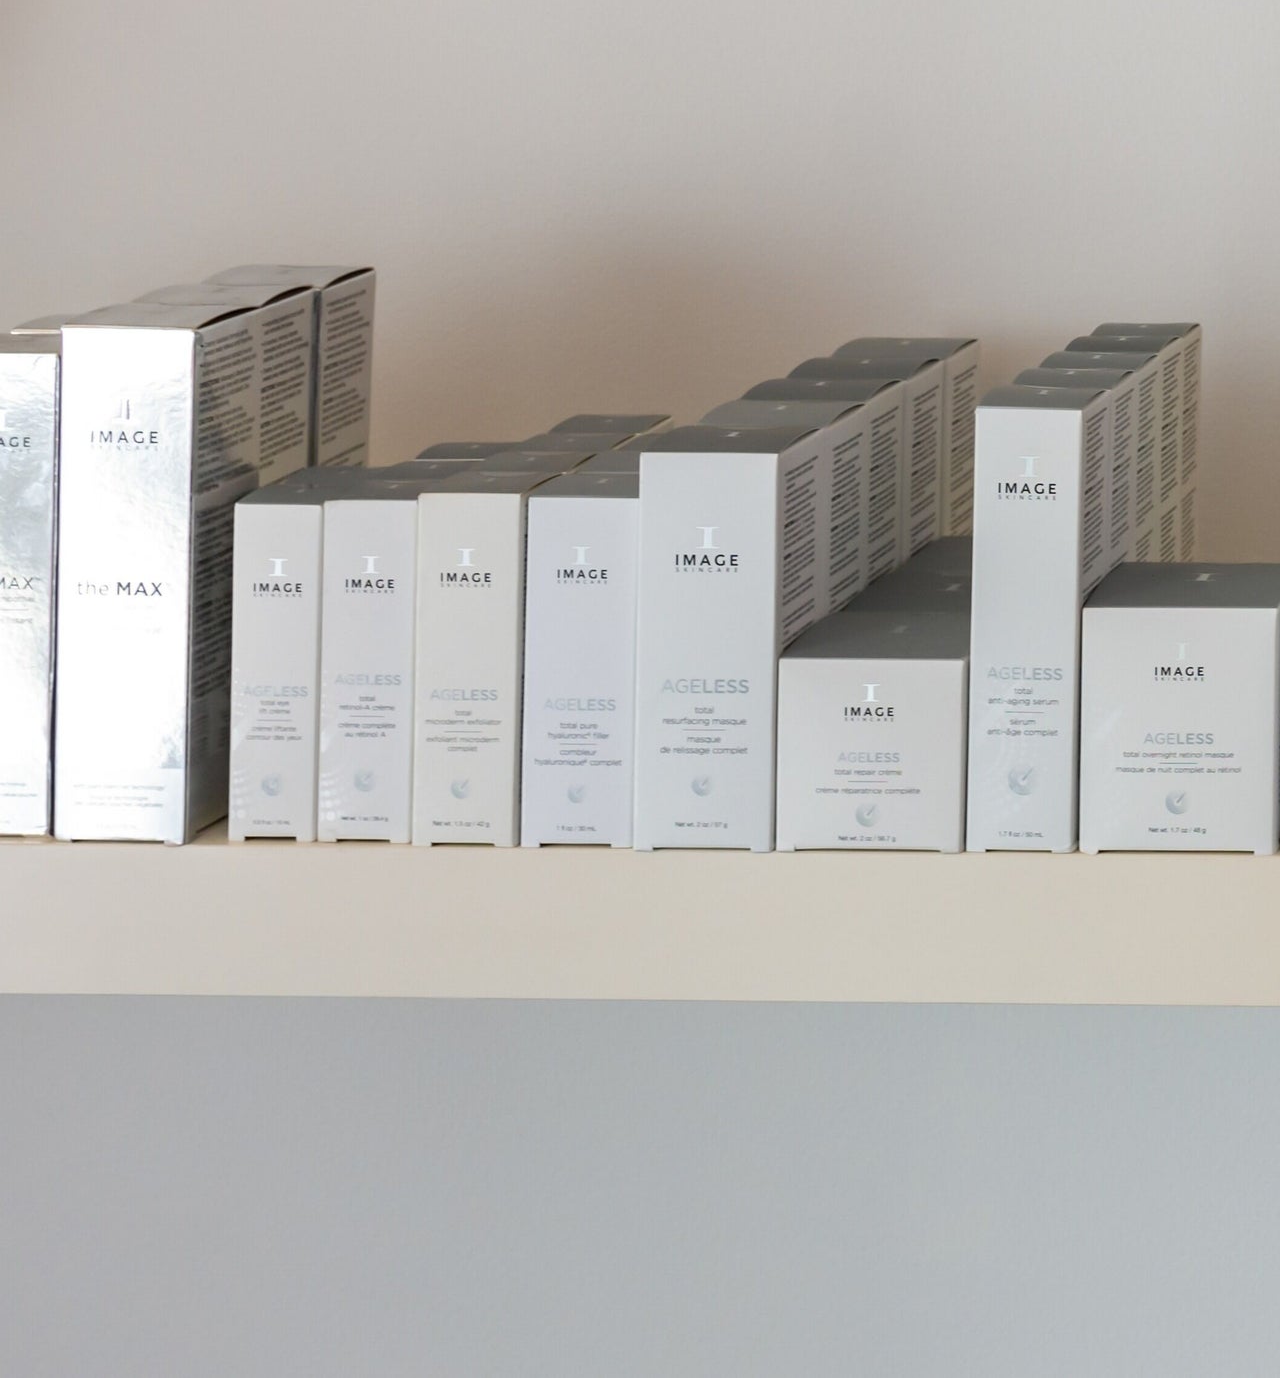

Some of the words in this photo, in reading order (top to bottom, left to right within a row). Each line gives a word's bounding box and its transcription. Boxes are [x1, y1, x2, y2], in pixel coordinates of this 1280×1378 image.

[91, 431, 158, 443] IMAGE
[676, 555, 738, 566] IMAGE
[117, 582, 162, 596] MAX
[663, 679, 749, 694] AGELESS
